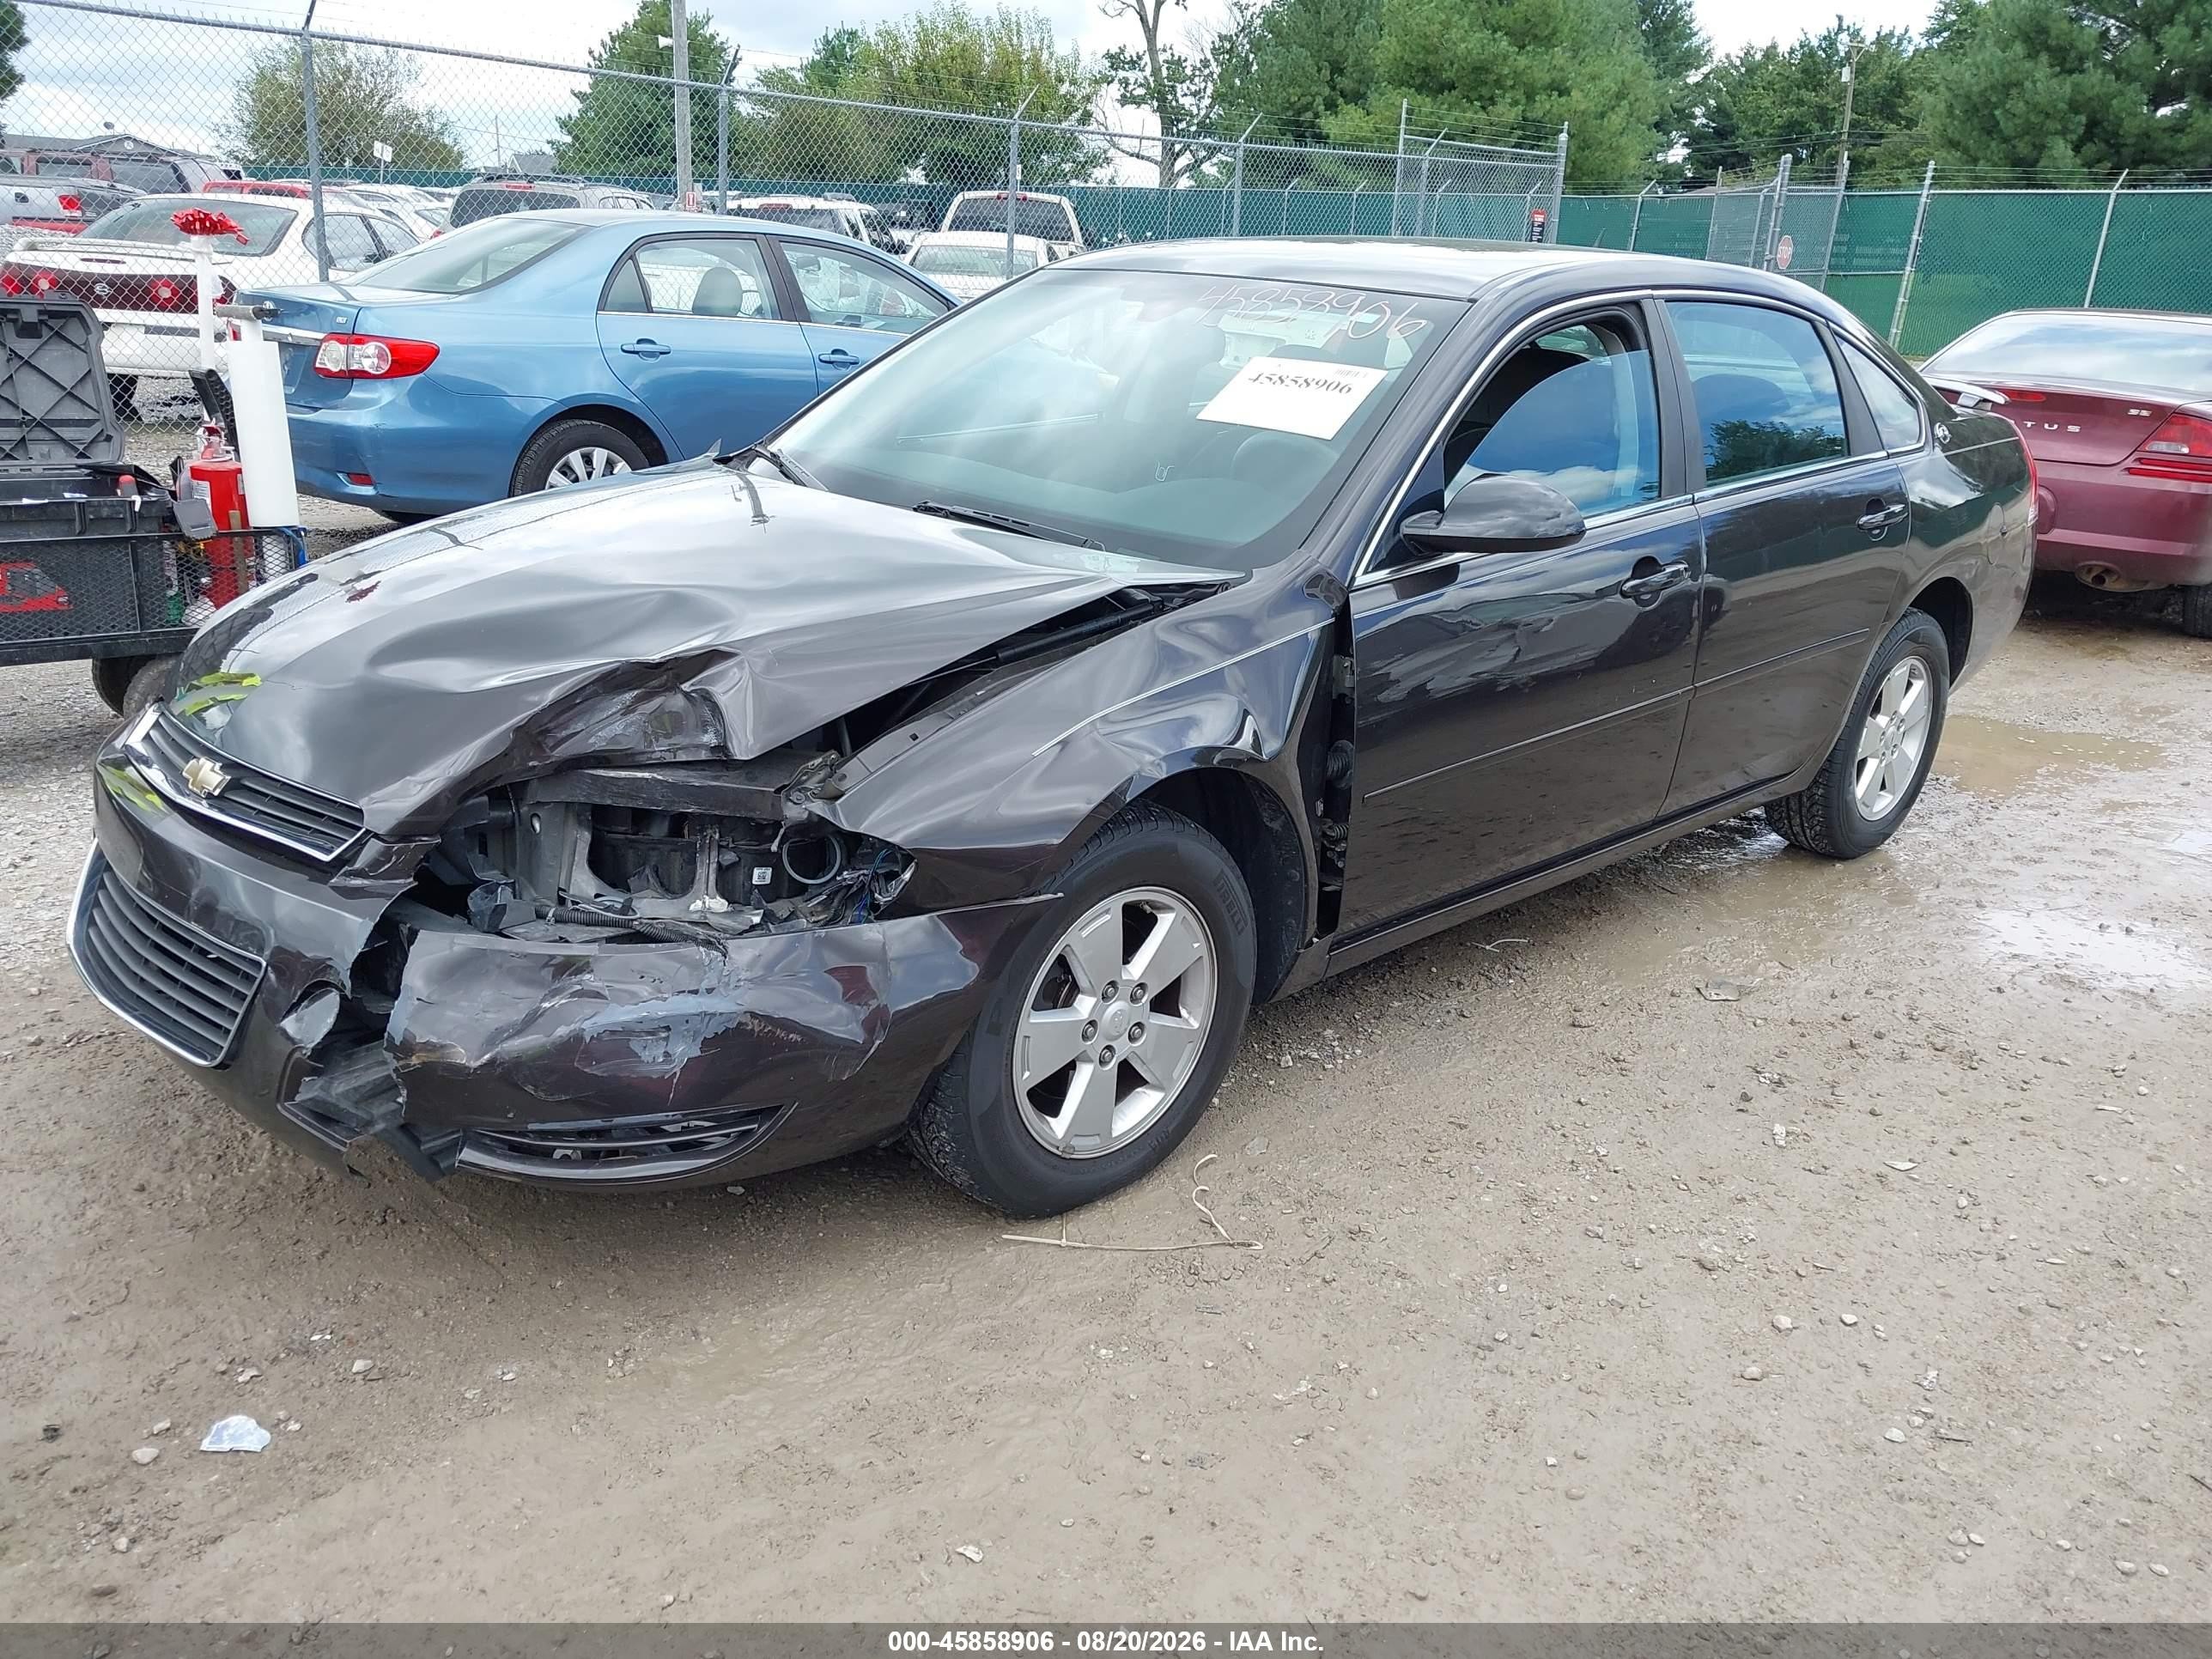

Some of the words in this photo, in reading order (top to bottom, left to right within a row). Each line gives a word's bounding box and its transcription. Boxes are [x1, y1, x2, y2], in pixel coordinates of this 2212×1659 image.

[1778, 246, 1791, 259] STOP
[1195, 284, 1427, 339] 45858906
[1248, 372, 1353, 395] 45858906
[2127, 408, 2153, 416] SE
[1212, 868, 1249, 936] PIRELLI
